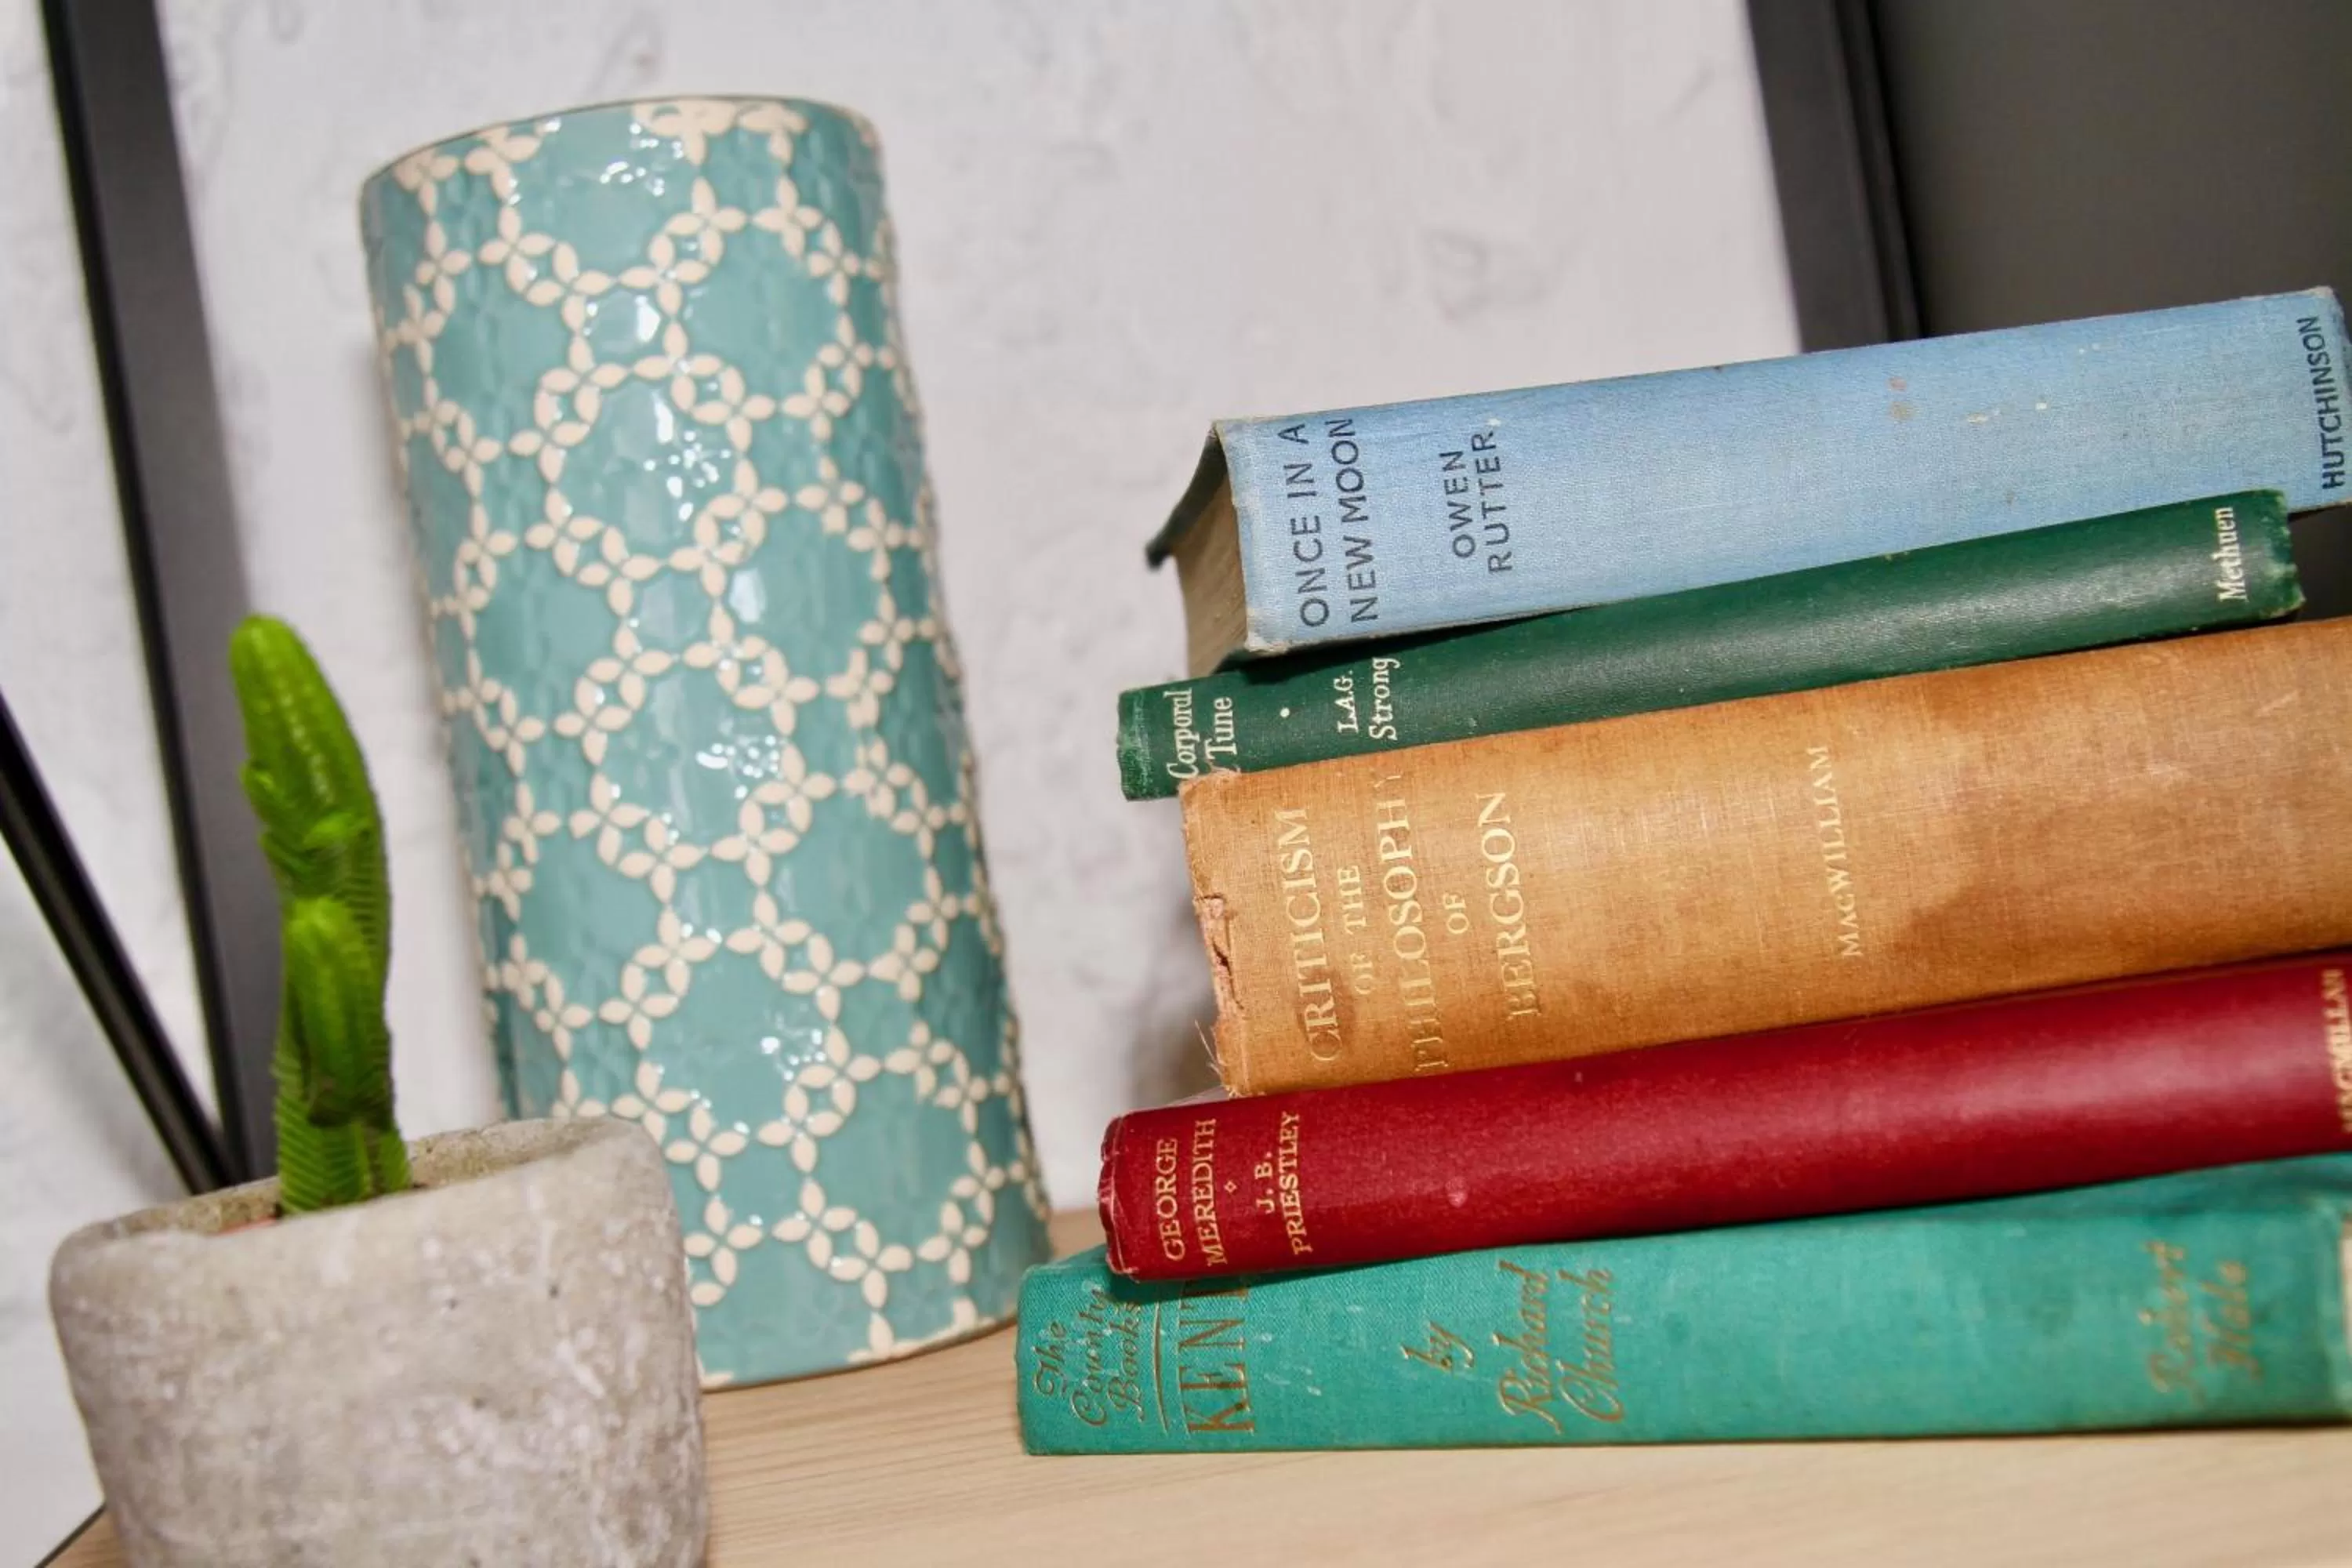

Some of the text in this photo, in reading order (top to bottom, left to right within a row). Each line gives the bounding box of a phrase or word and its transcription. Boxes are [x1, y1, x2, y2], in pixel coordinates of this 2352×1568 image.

[2296, 315, 2345, 489] HUTCHINSON
[1277, 423, 1330, 627] ONCE IN A
[1324, 418, 1379, 623] NEW MOON
[1439, 449, 1477, 558] OWEN
[1471, 430, 1513, 574] RUTTER
[2210, 506, 2249, 603] Methuen
[1163, 687, 1200, 779] Corporal
[1204, 696, 1238, 756] Tune
[1368, 657, 1401, 741] Strong
[1275, 808, 1343, 1062] CRITICISM
[1337, 864, 1375, 996] OF THE
[1370, 768, 1450, 1072] PHILOSOPHY
[1443, 891, 1469, 935] OF
[1475, 791, 1542, 1021] BERGSON
[1155, 1138, 1186, 1261] GEORGE
[1192, 1118, 1228, 1267] MEREDITH
[1254, 1151, 1276, 1214] J. B.
[1279, 1110, 1313, 1255] PRIESTLEY
[1032, 1320, 1068, 1398] The
[1069, 1287, 1112, 1427] County
[1107, 1301, 1145, 1423] Books
[1399, 1319, 1475, 1369] by
[1492, 1258, 1564, 1434] Richard
[1555, 1269, 1625, 1423] Church
